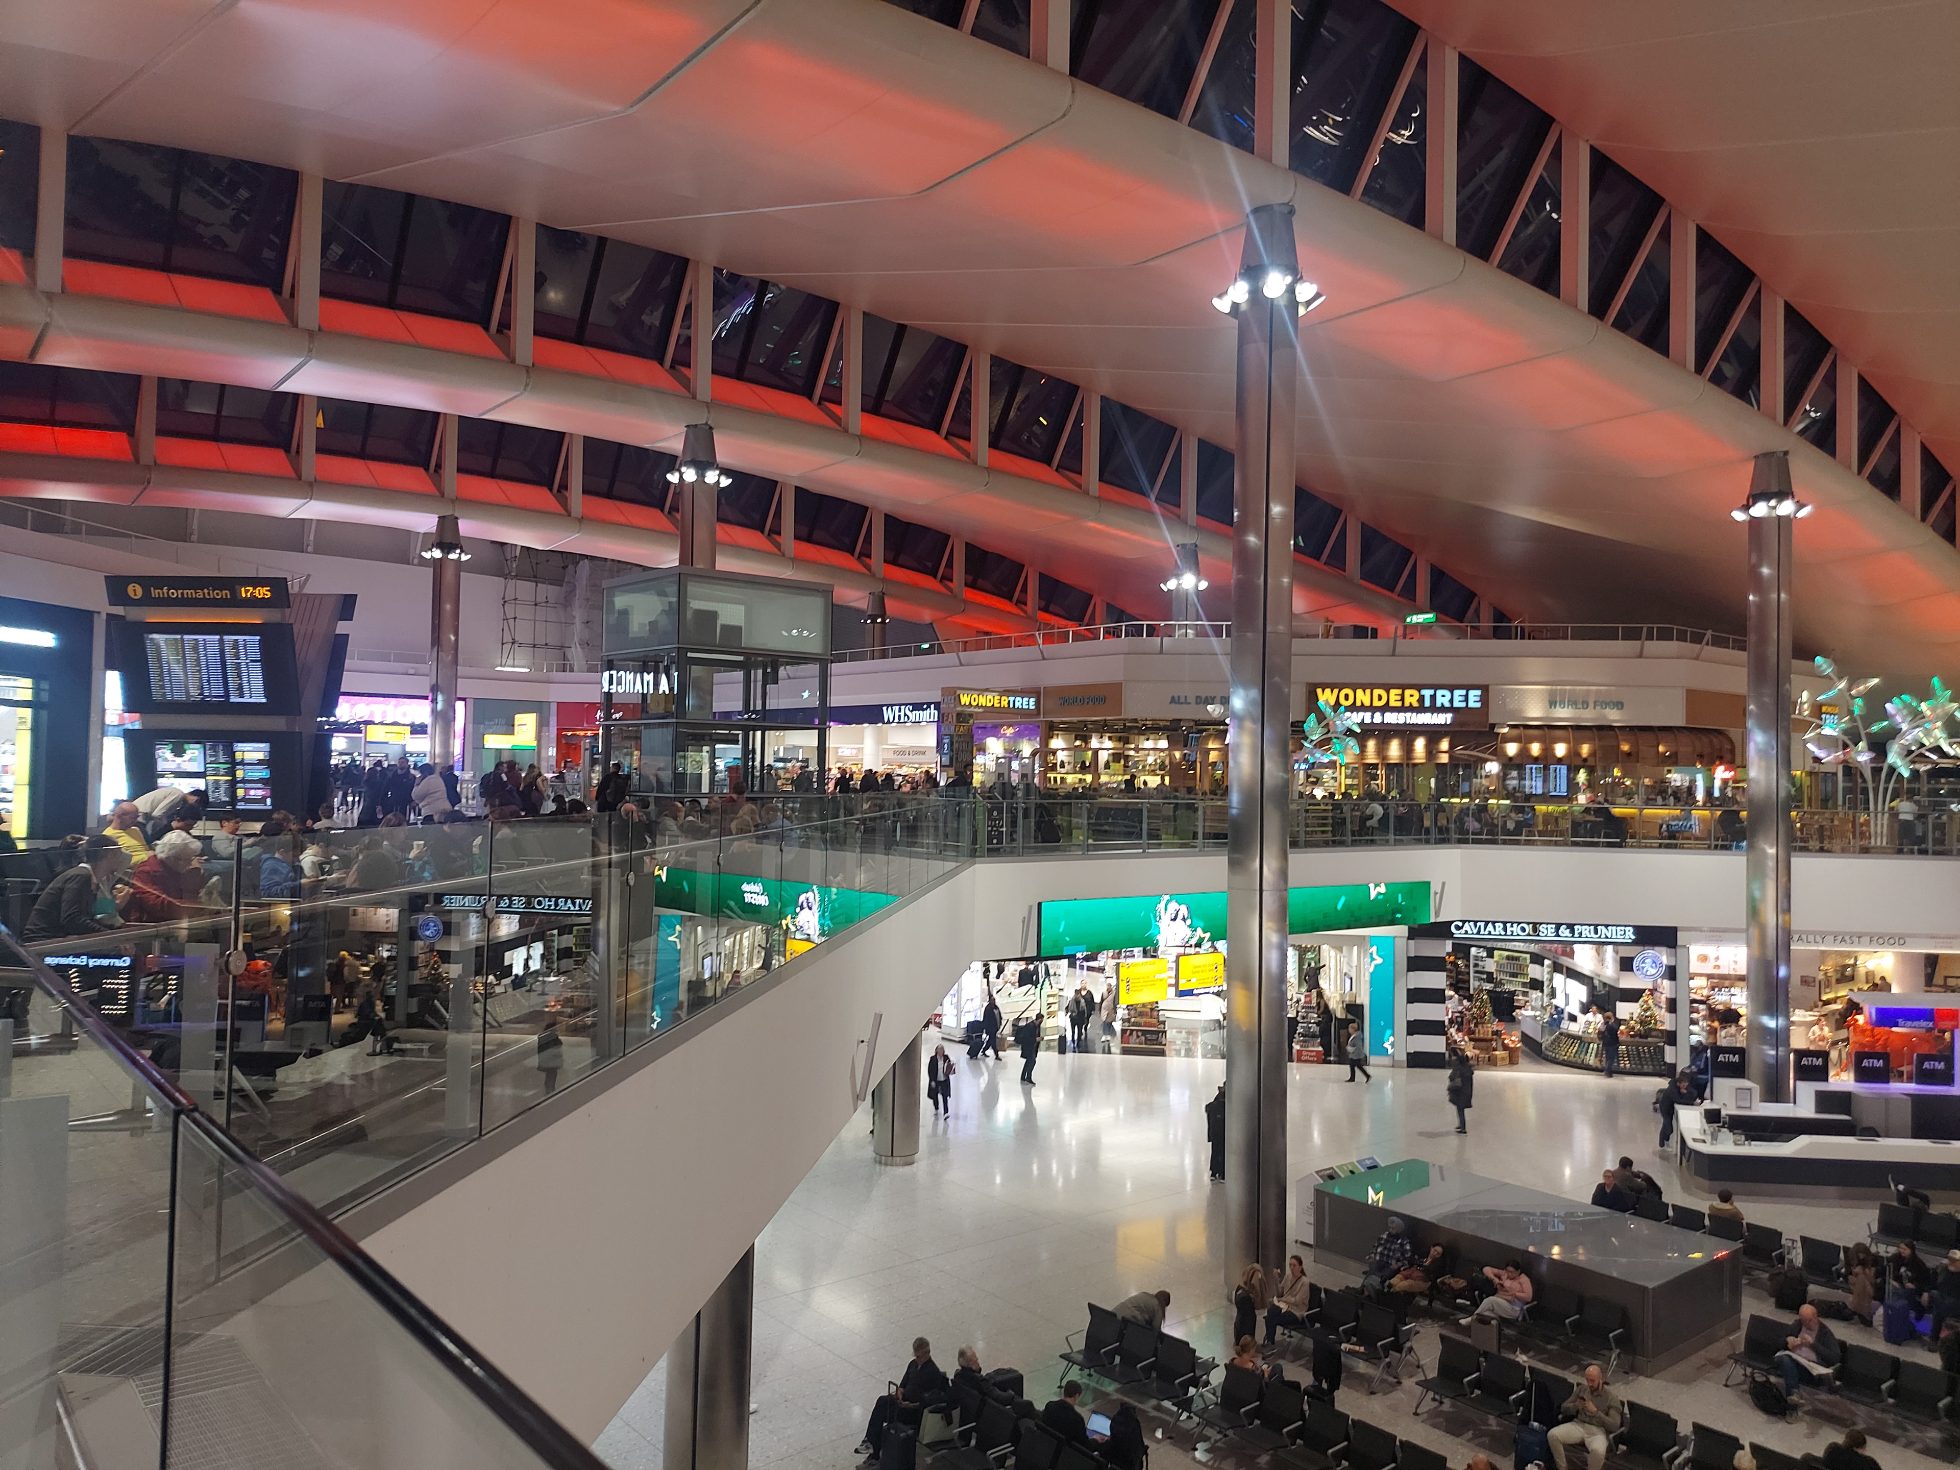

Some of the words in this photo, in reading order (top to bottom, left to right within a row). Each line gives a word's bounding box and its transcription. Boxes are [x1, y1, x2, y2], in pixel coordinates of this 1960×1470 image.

[150, 586, 231, 599] Information
[240, 586, 271, 598] 17:05
[959, 693, 1036, 710] WONDERTREE
[1169, 695, 1191, 704] ALL
[1195, 695, 1216, 705] DAY
[1316, 687, 1482, 708] WONDERTREE
[1548, 699, 1589, 710] WORLD
[1593, 700, 1624, 710] FOOD
[882, 704, 939, 723] WHSmith
[1383, 712, 1454, 725] RESTAURANT
[893, 749, 906, 757] FOOD
[1450, 921, 1504, 935] CAVIAR
[1504, 922, 1555, 937] HOUSE
[1558, 924, 1572, 937] &
[1573, 925, 1636, 940] PRUNIER
[1832, 935, 1863, 945] FAST
[1868, 935, 1906, 947] FOOD
[1717, 1053, 1739, 1064] ATM
[1800, 1056, 1823, 1066] ATM
[1862, 1058, 1884, 1068] ATM
[1922, 1060, 1945, 1071] ATM
